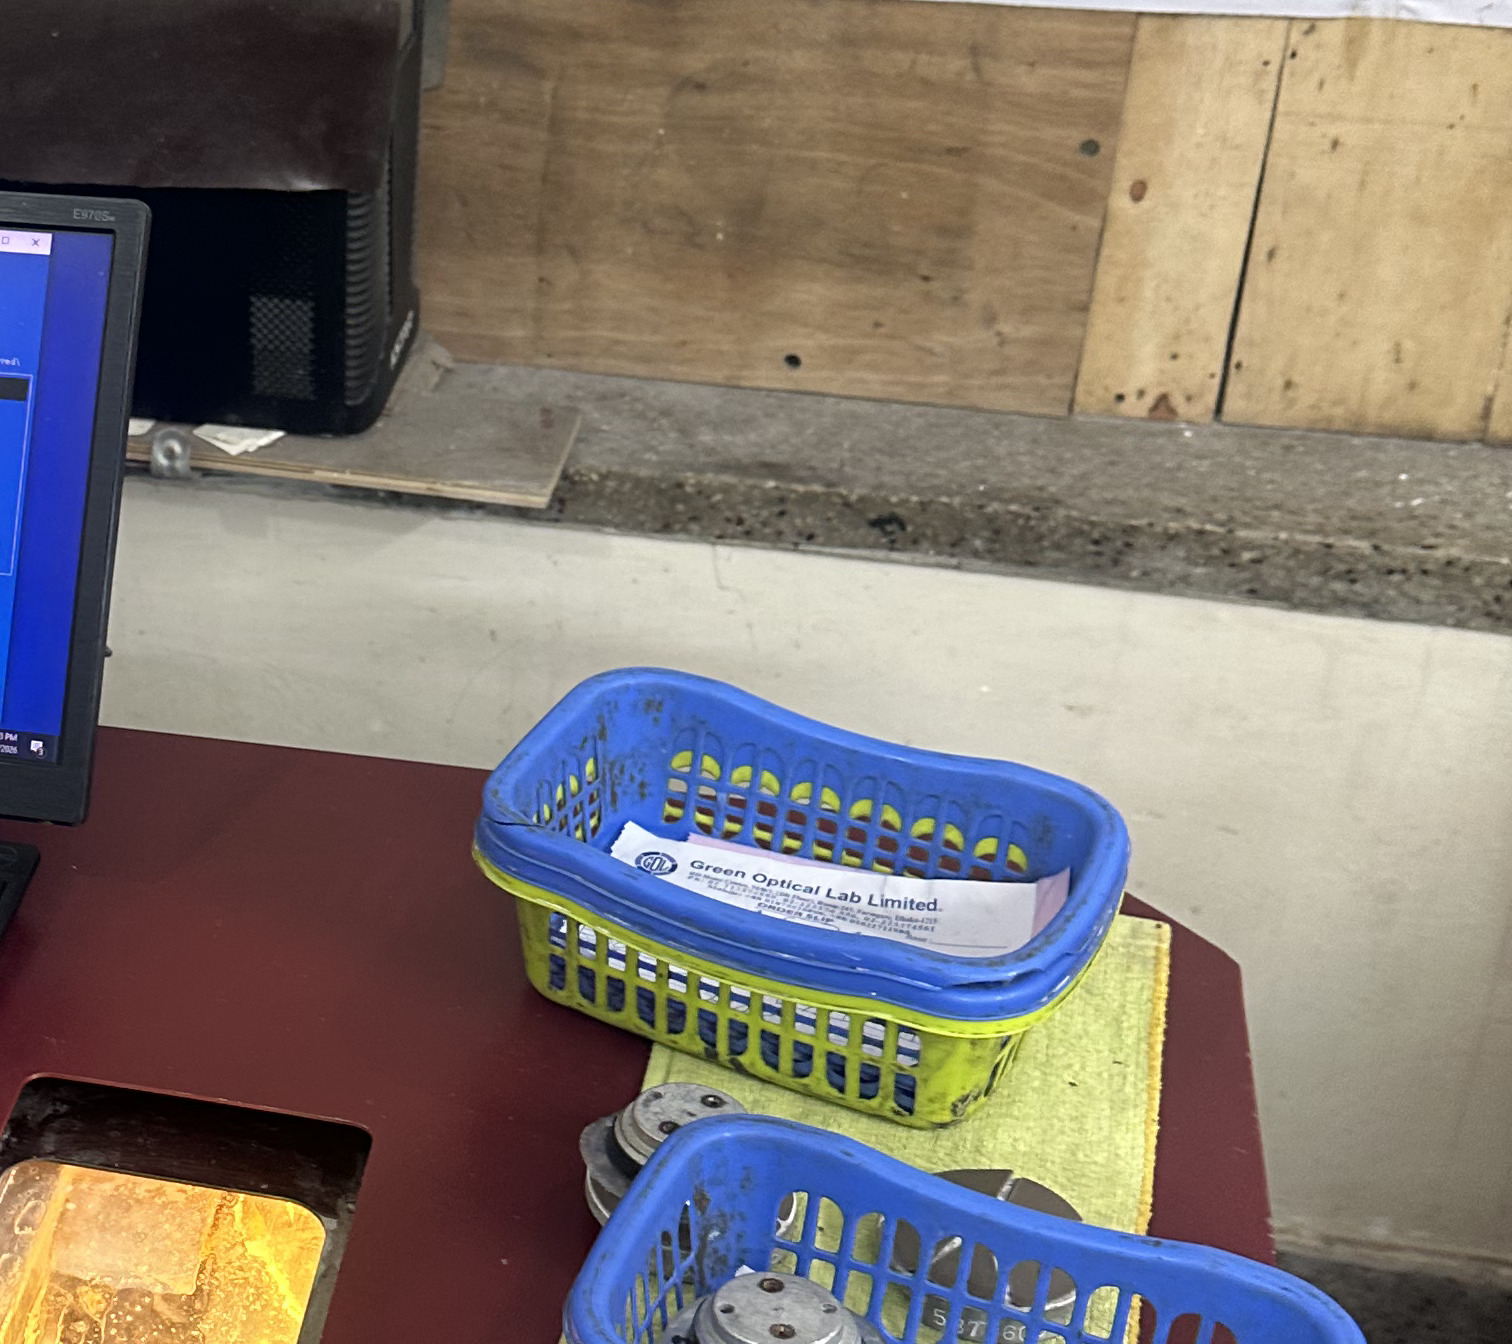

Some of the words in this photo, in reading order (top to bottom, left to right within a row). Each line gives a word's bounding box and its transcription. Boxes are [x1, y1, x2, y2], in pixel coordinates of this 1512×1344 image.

[689, 859, 746, 880] Green
[752, 872, 821, 897] Optical
[826, 887, 862, 906] Lab
